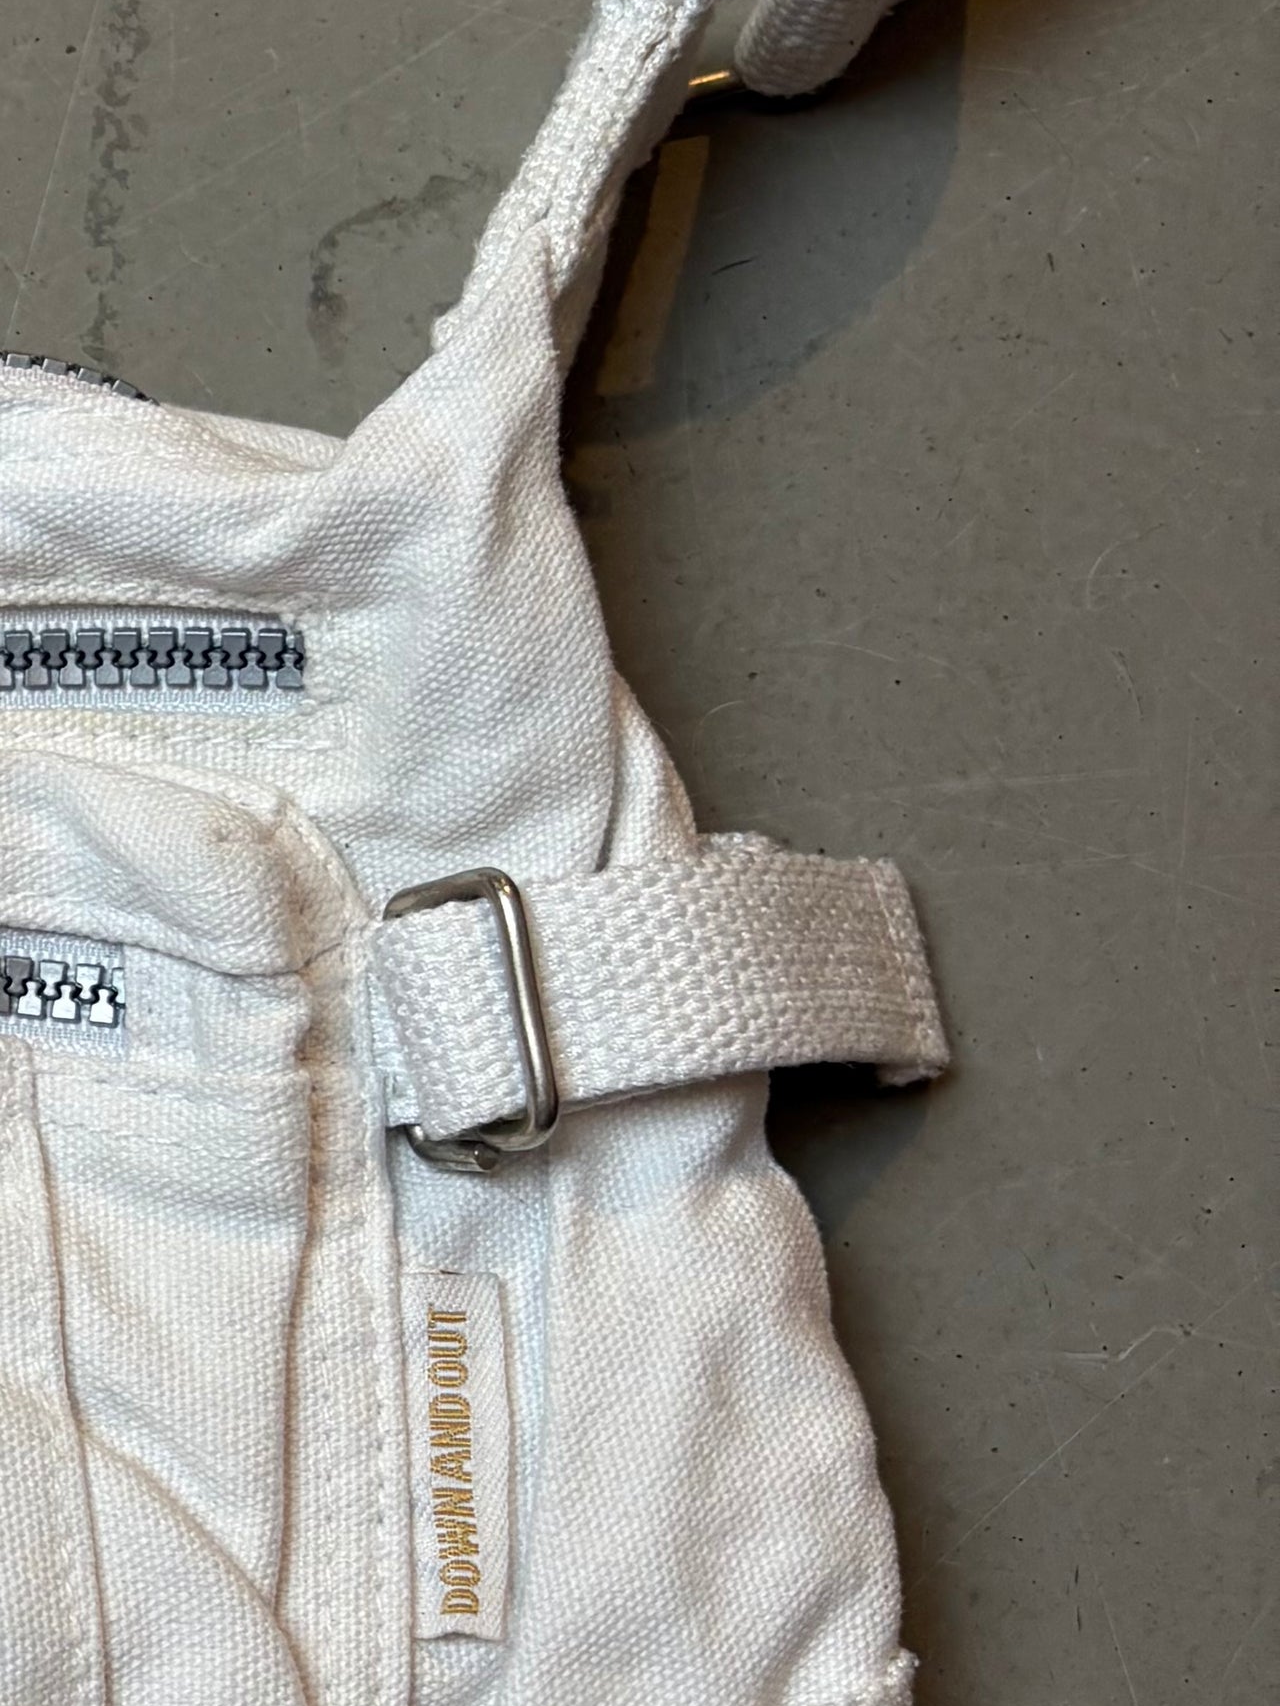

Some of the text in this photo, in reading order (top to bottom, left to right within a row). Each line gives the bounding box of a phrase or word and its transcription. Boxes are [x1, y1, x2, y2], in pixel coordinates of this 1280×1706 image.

[426, 1302, 481, 1616] DOWN AND OUT
